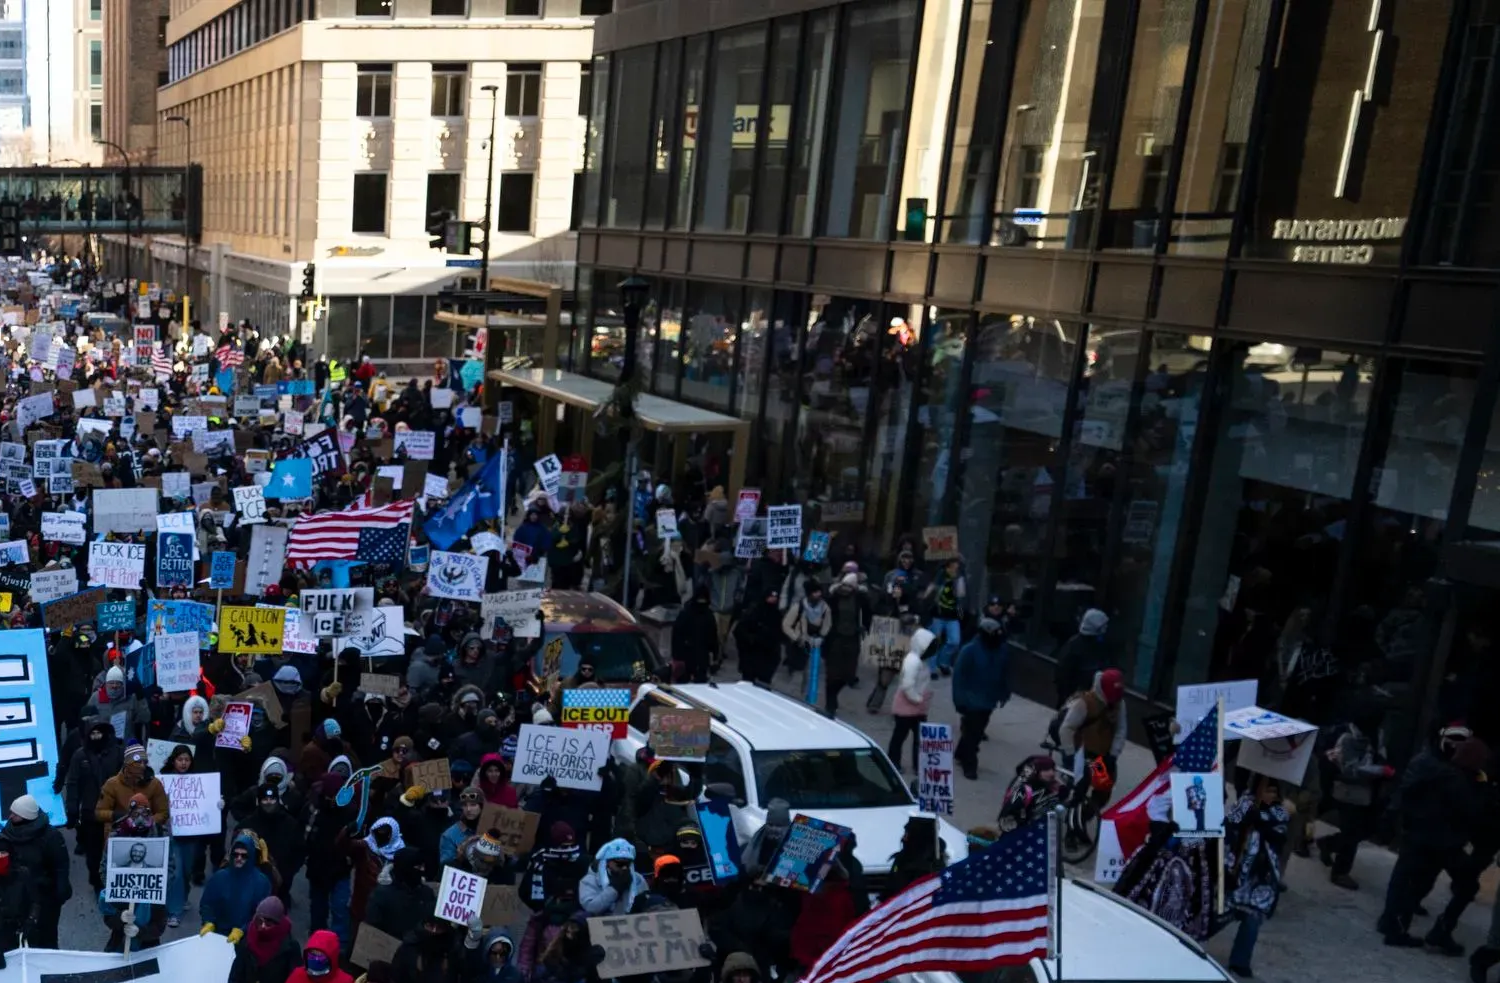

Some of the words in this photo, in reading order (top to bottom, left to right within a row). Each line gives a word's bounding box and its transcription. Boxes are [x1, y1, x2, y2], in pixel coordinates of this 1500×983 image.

[137, 329, 152, 340] NO
[137, 346, 152, 357] NO
[235, 488, 261, 500] FUCK
[239, 500, 265, 521] ICE
[770, 509, 800, 518] GENERAL
[769, 536, 800, 546] JUSTICE
[92, 545, 124, 557] FUCK
[127, 546, 145, 561] ICE
[169, 545, 183, 559] BE
[160, 558, 193, 571] BETTER
[103, 605, 129, 613] LOVE
[304, 594, 354, 612] FUCK
[230, 609, 280, 624] CAUTION
[159, 637, 168, 650] IF
[564, 708, 591, 721] ICE
[594, 708, 629, 721] OUT
[921, 726, 948, 739] OUR
[525, 733, 557, 752] ICE
[562, 737, 580, 755] IS
[582, 740, 597, 758] A
[527, 749, 596, 770] TERRORIST
[927, 753, 941, 765] IS
[418, 759, 444, 775] ICE
[522, 763, 594, 782] ORGANIZATION
[420, 774, 449, 789] OUT
[925, 767, 951, 784] NOT
[170, 777, 203, 790] MIGRA
[920, 783, 932, 795] UP
[933, 784, 951, 798] FOR
[919, 798, 953, 814] DEBATE
[111, 873, 164, 889] JUSTICE
[451, 872, 478, 893] ICE
[109, 888, 131, 899] ALEX
[132, 890, 163, 901] PRETTI
[449, 890, 475, 907] OUT
[601, 914, 682, 941] ICE
[605, 941, 658, 967] OUT
[664, 939, 703, 964] MN
